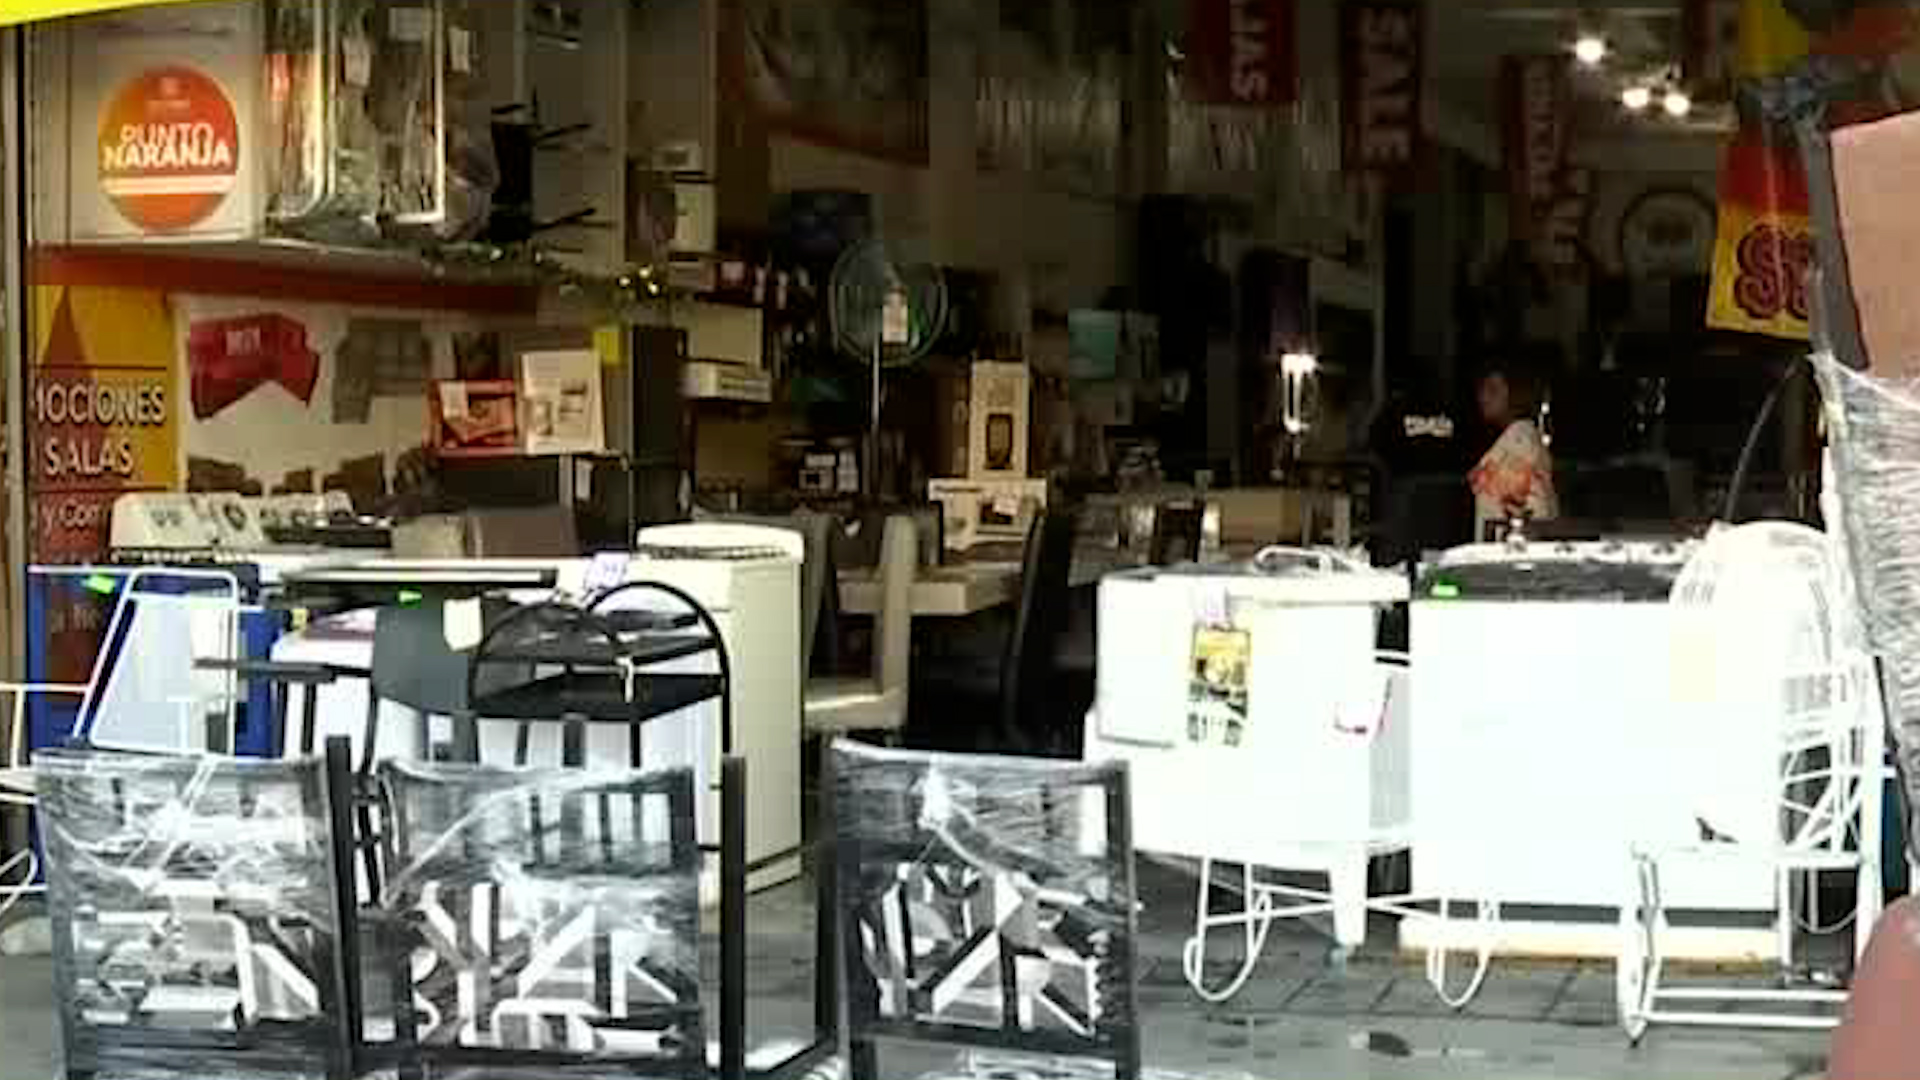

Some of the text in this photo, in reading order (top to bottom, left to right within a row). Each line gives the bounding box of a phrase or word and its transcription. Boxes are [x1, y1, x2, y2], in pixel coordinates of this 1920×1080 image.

[1358, 8, 1412, 163] SALE
[119, 121, 215, 147] PUNTO
[102, 139, 234, 171] NARANJA
[44, 436, 134, 476] SALAS
